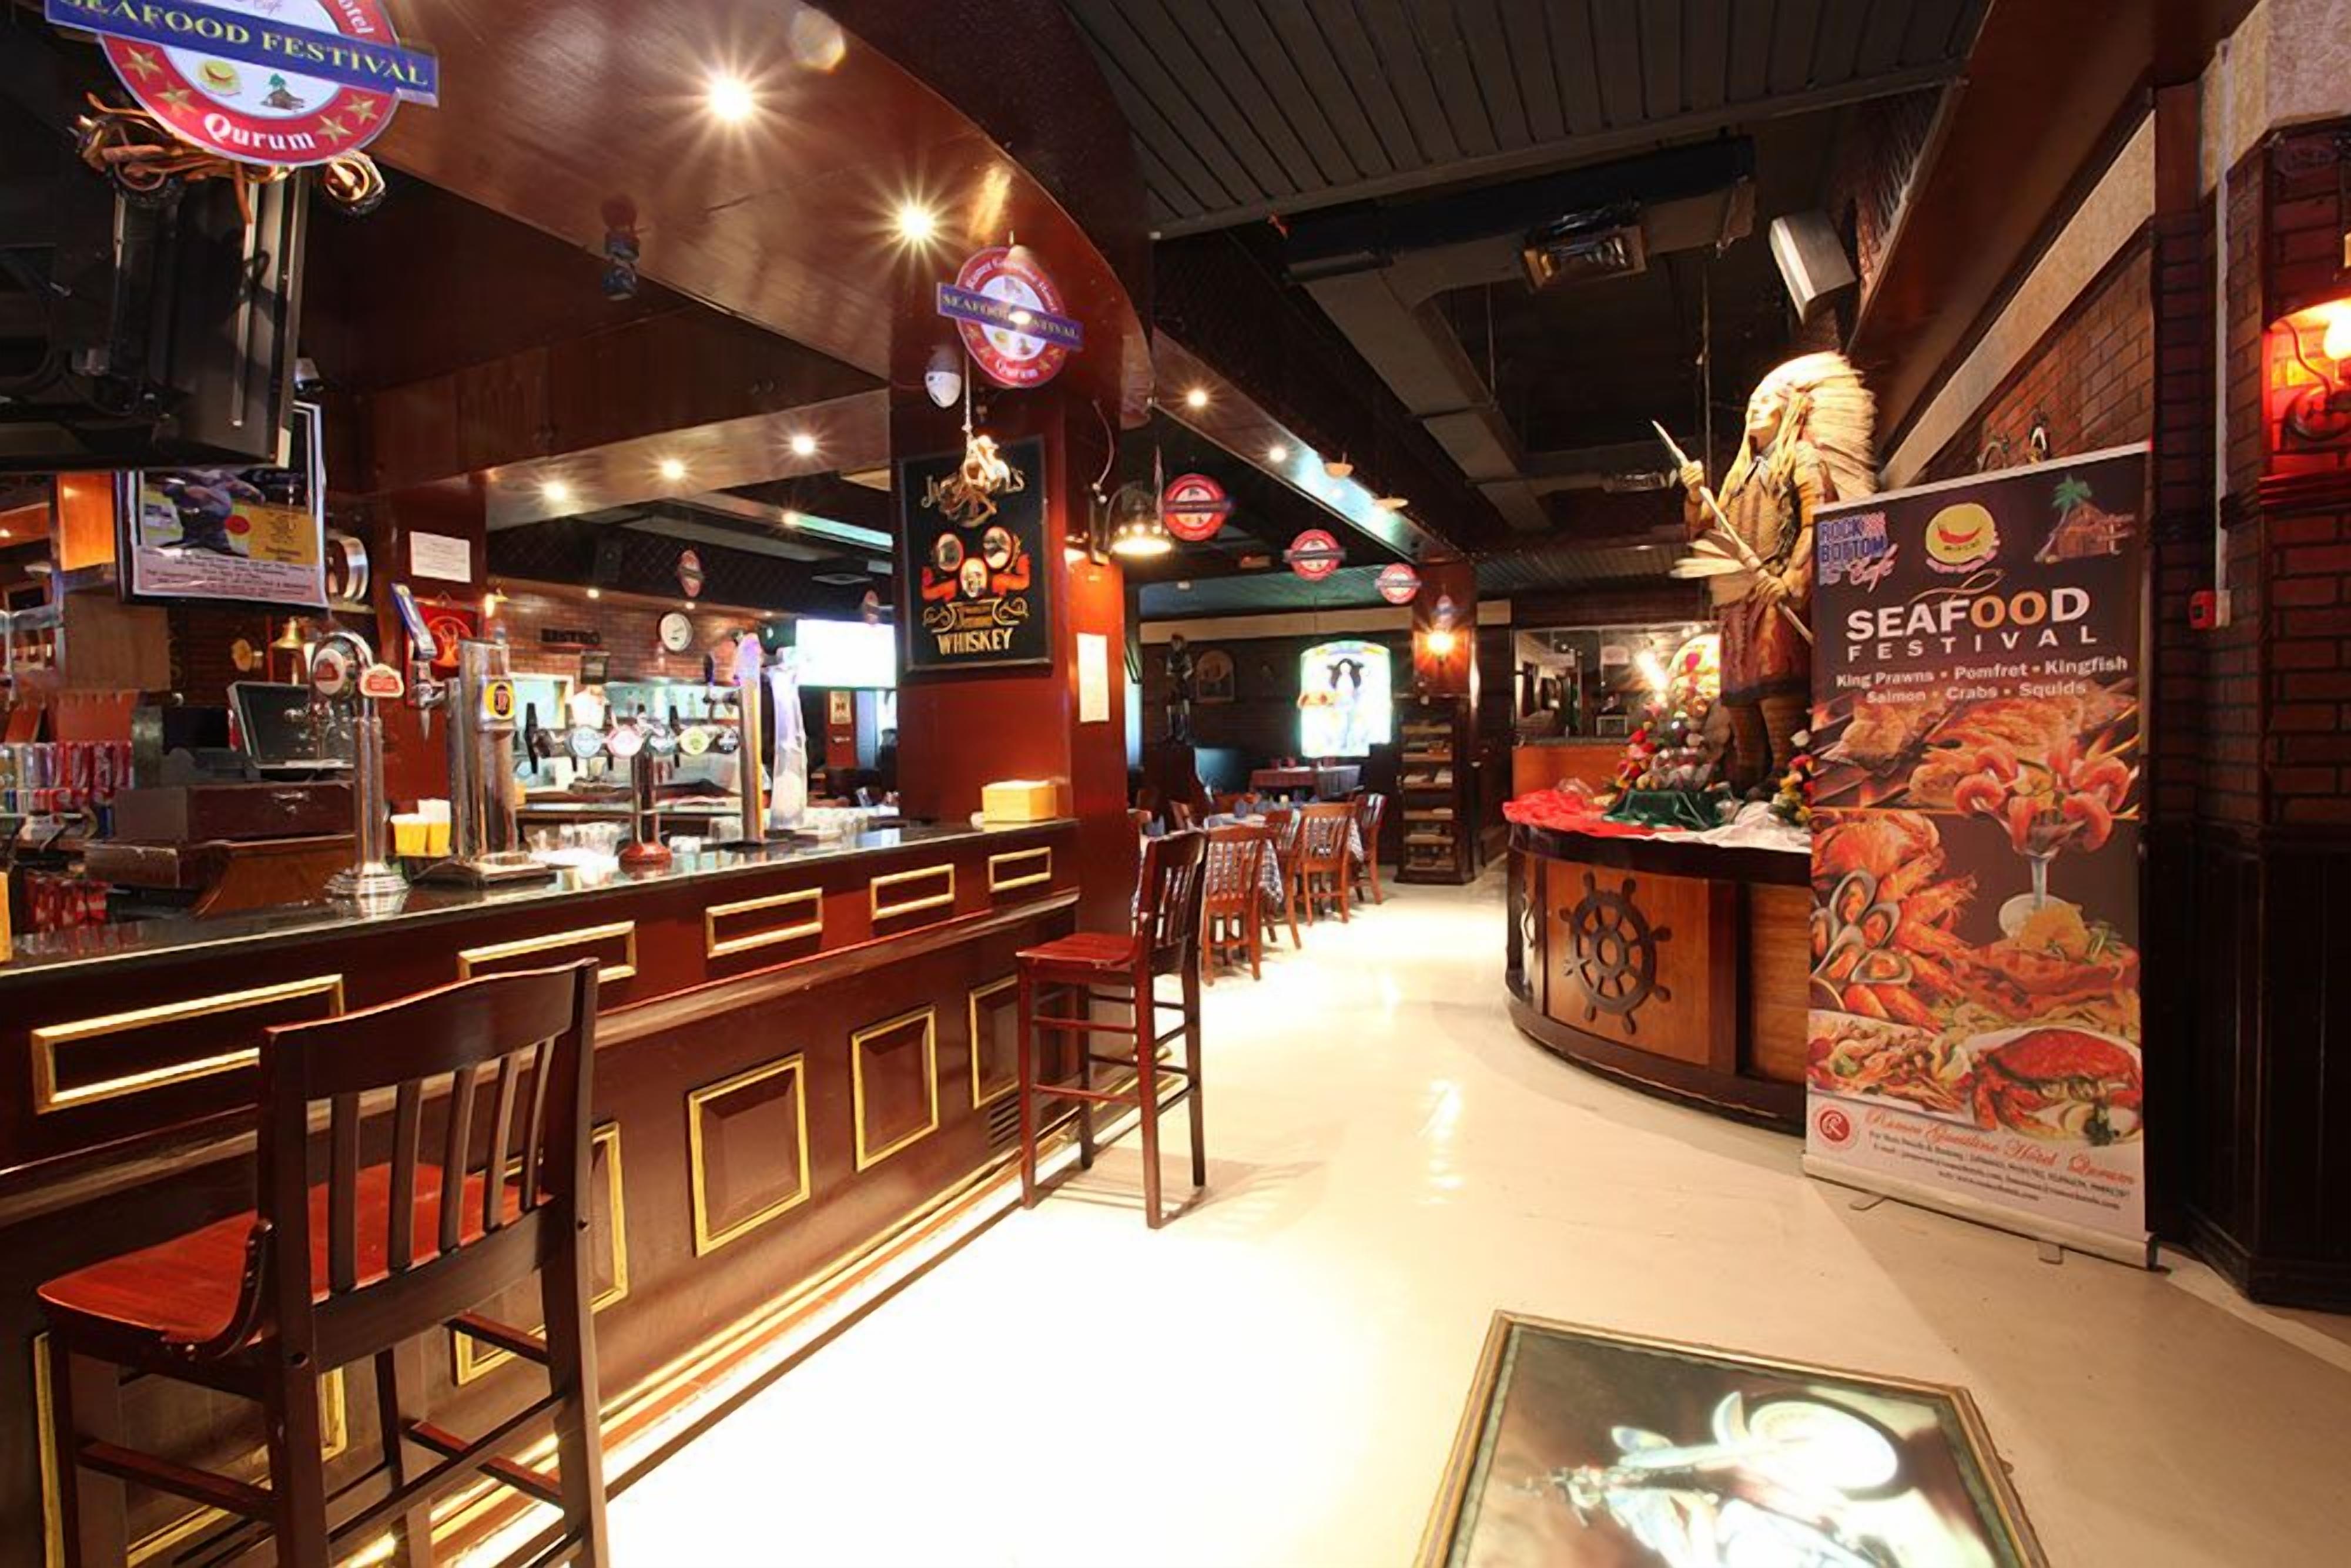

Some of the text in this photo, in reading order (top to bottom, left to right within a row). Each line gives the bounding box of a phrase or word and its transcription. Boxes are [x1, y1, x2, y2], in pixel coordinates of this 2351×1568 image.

[338, 0, 374, 33] otel
[262, 31, 428, 85] FESTIVAL
[203, 112, 316, 150] Qurum
[1846, 587, 2091, 641] SEAFOOD
[936, 627, 1014, 655] WHISKEY
[1848, 625, 2097, 662] FESTIVAL
[1836, 656, 2128, 689] King Prawns Pomfret Kingfish
[1867, 680, 2086, 704] Salmon Crabs Squids
